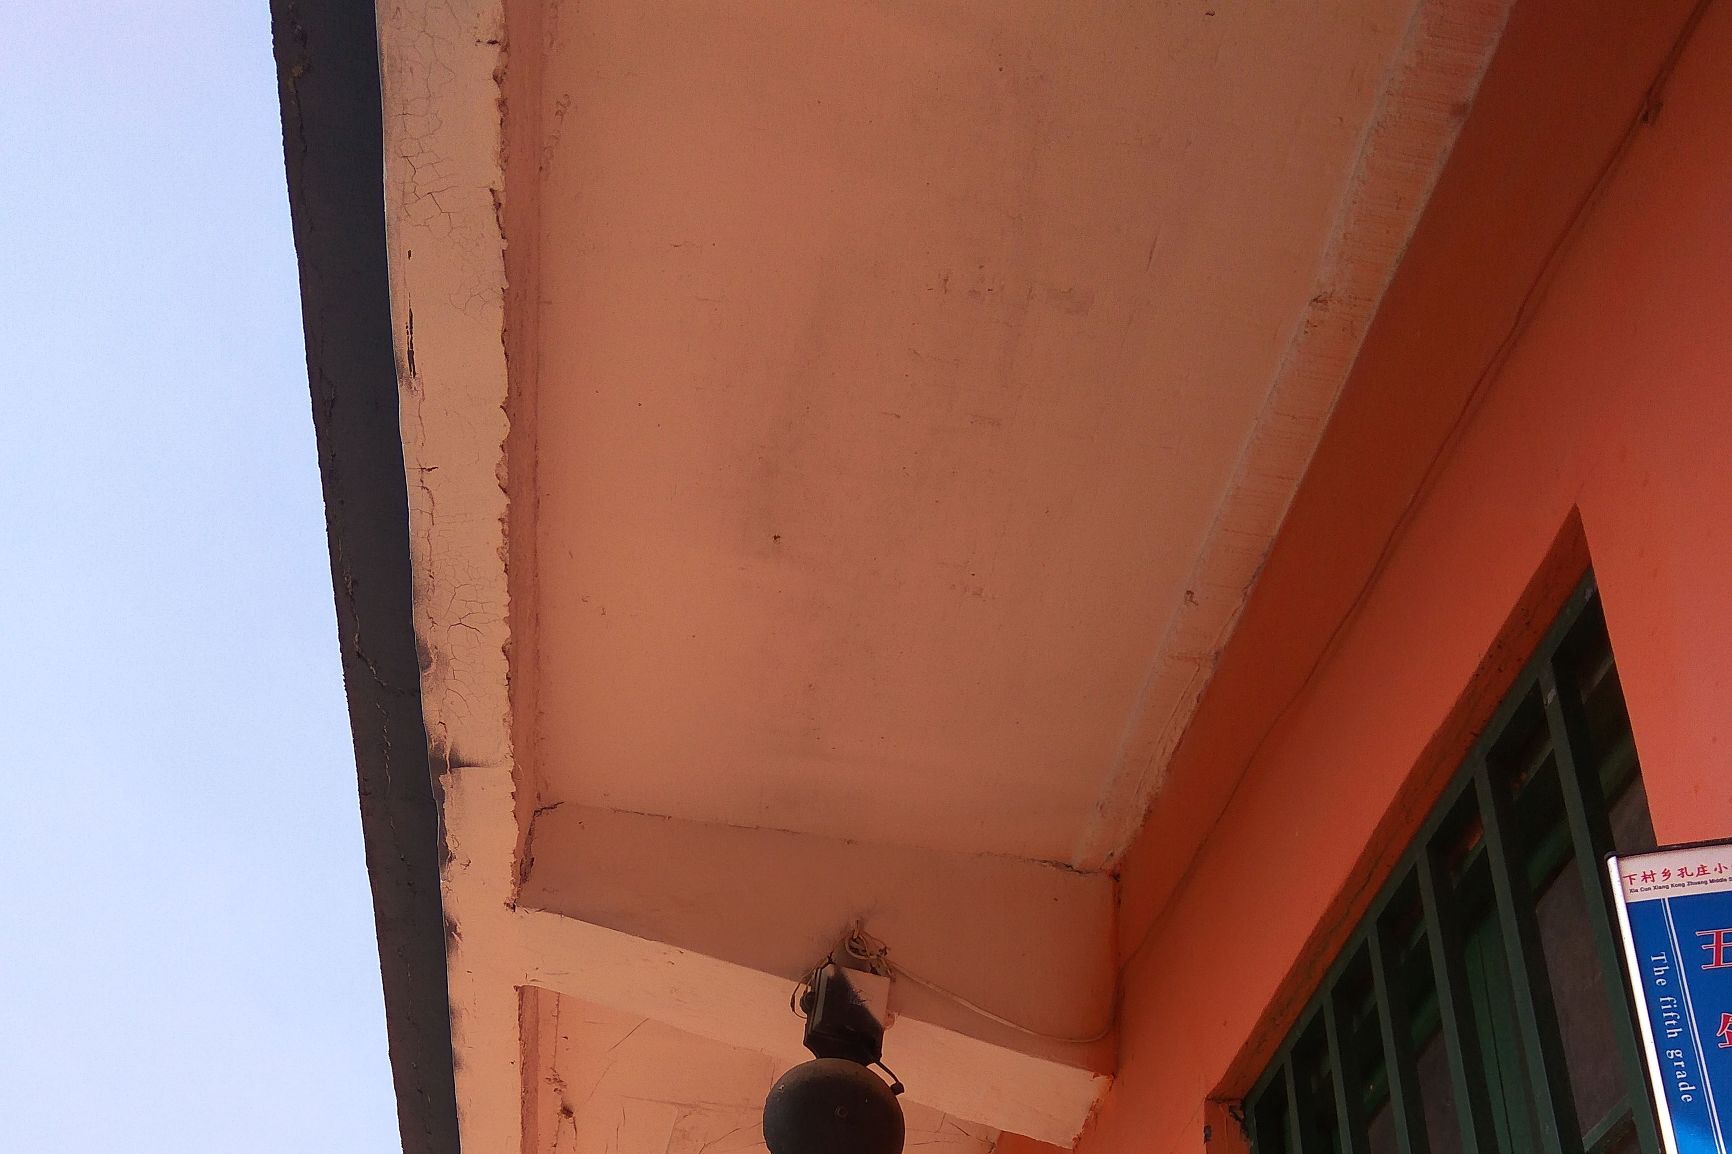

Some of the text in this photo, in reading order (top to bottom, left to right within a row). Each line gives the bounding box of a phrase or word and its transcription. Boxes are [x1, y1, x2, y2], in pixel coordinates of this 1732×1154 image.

[1622, 863, 1732, 885] 下村乡孔庄小
[1650, 951, 1697, 1103] The fifth grade
